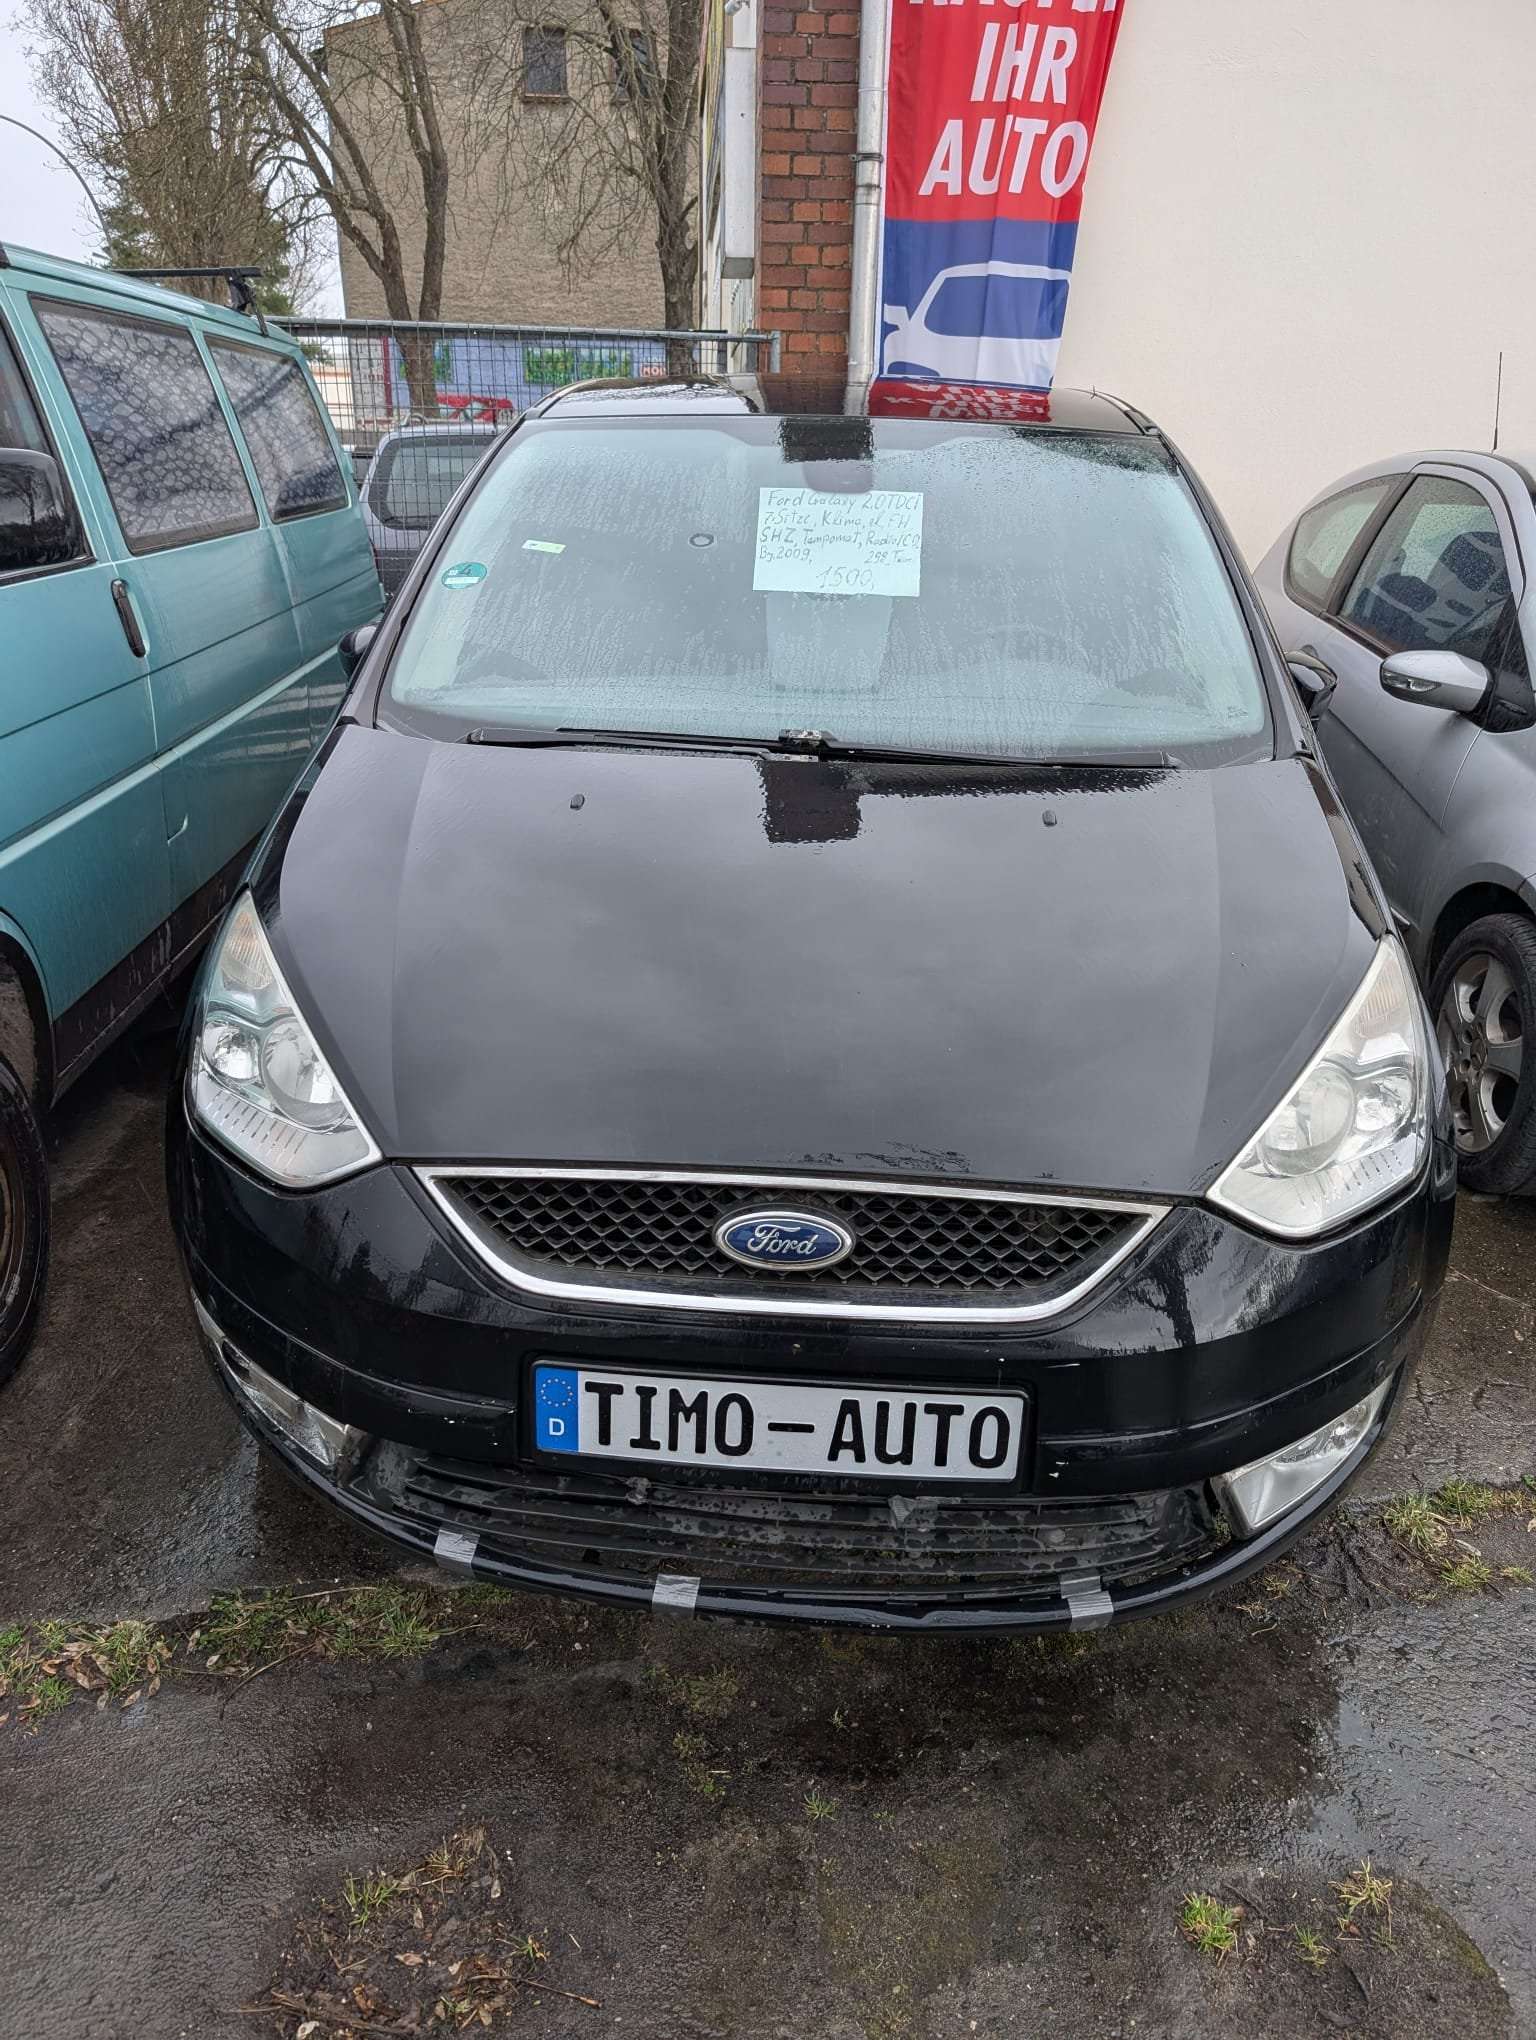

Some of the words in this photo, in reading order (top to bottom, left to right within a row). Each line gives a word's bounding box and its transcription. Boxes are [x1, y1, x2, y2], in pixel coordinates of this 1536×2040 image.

[970, 22, 1077, 105] IHR
[918, 115, 1089, 199] AUTO
[768, 489, 806, 506] Ford
[747, 1223, 817, 1256] Ford
[549, 1418, 565, 1436] D
